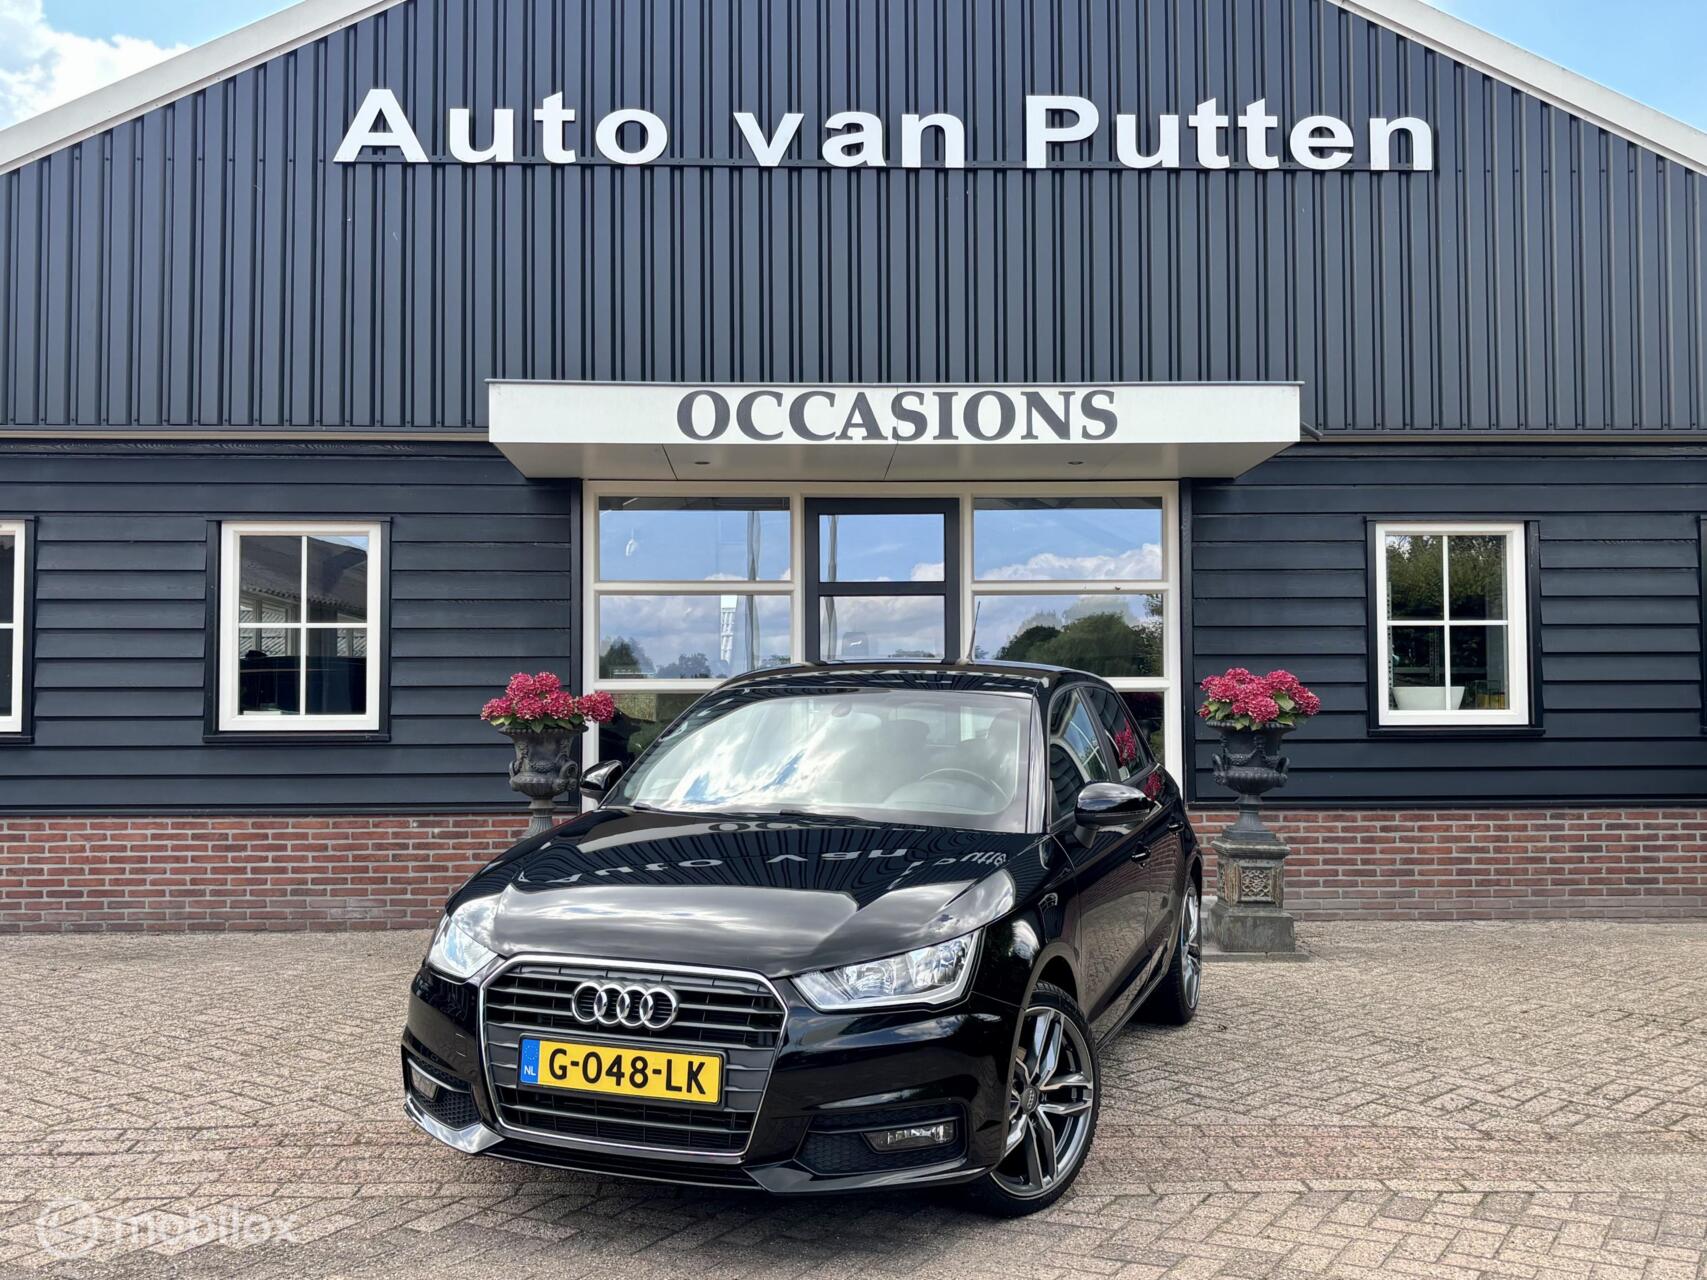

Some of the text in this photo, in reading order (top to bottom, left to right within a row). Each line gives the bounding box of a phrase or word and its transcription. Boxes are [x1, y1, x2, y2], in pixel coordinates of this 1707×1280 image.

[333, 88, 1433, 171] Auto van Putten
[677, 389, 1118, 442] OCCASIONS
[523, 1065, 537, 1076] NL
[548, 1047, 707, 1096] G-048-LK
